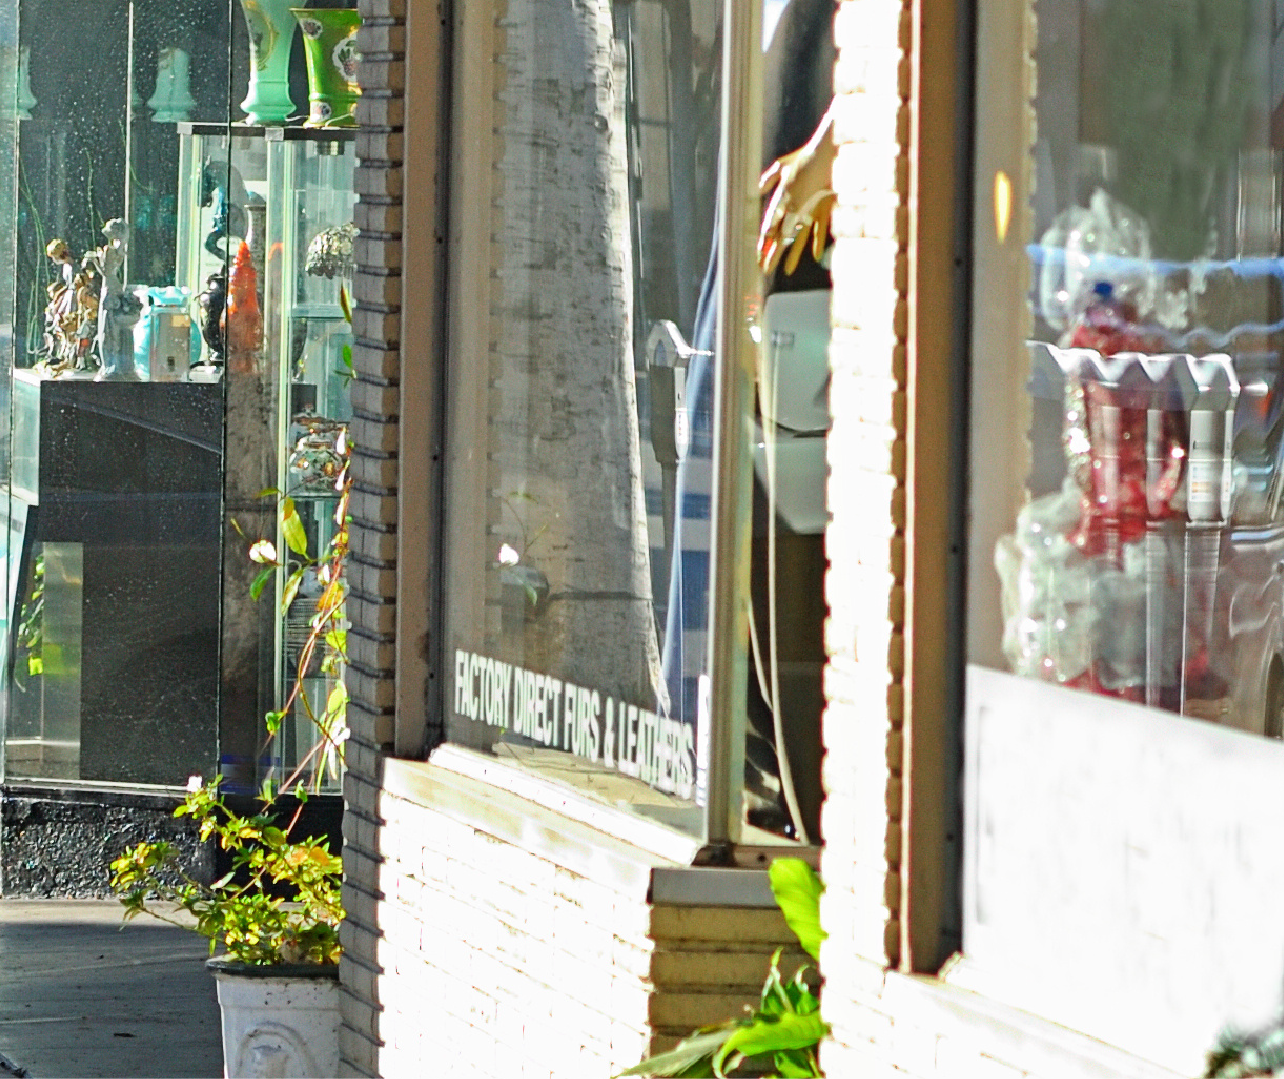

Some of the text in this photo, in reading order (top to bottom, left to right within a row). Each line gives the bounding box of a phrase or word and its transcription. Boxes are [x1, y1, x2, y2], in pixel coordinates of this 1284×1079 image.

[454, 648, 694, 800] FACTORY DIRECT FURS & LEATHERS
